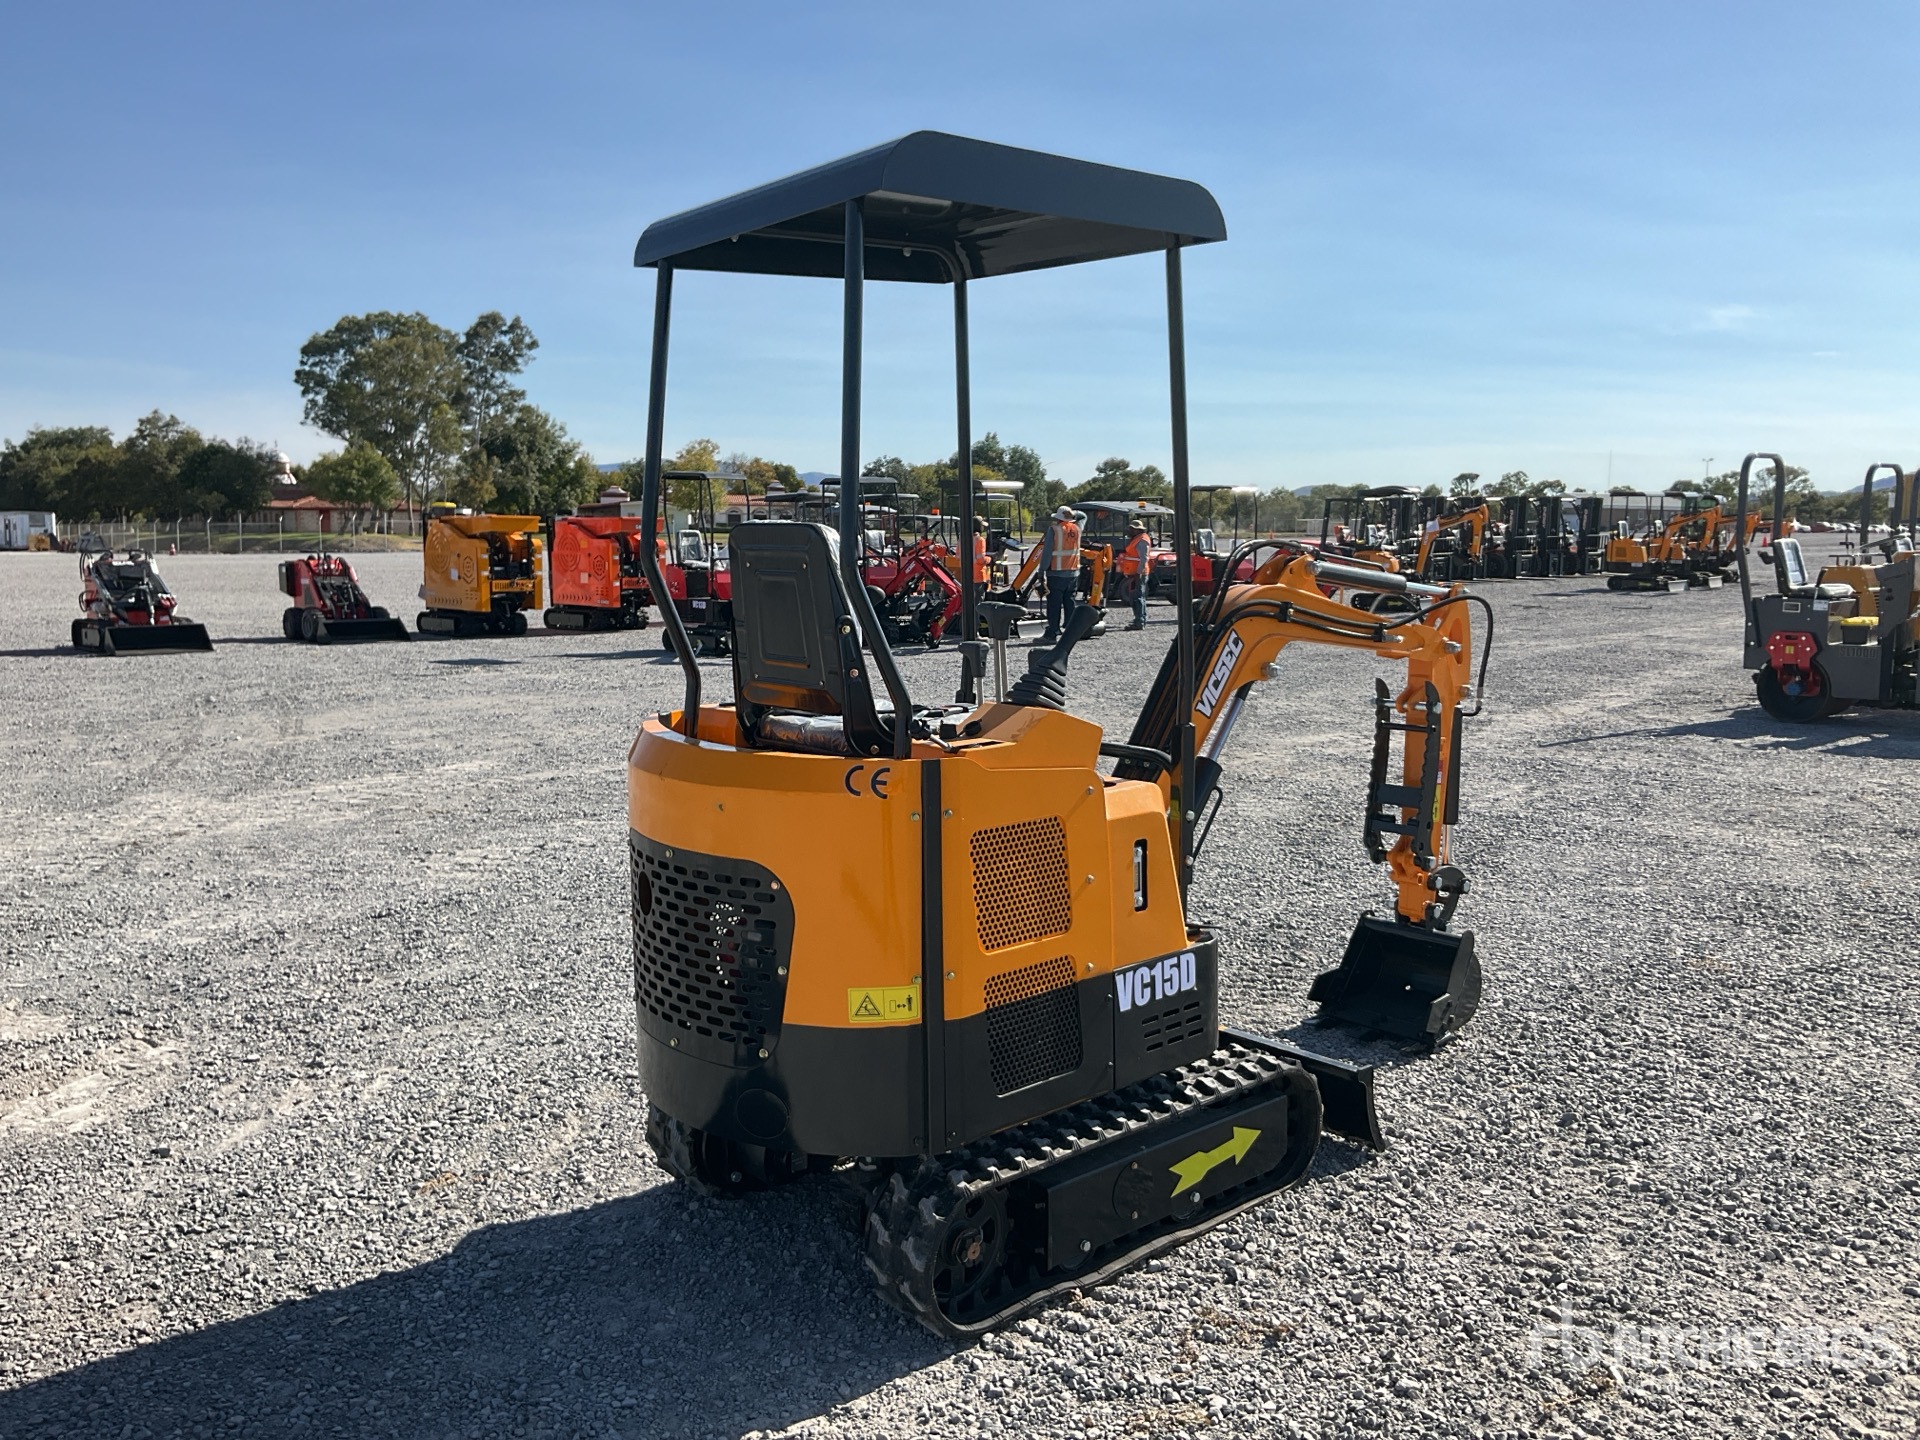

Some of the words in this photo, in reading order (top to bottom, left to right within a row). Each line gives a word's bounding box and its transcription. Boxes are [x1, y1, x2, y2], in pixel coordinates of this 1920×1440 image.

[1195, 629, 1244, 717] VICSEC
[845, 765, 890, 799] CE
[1115, 952, 1196, 1012] VC15D
